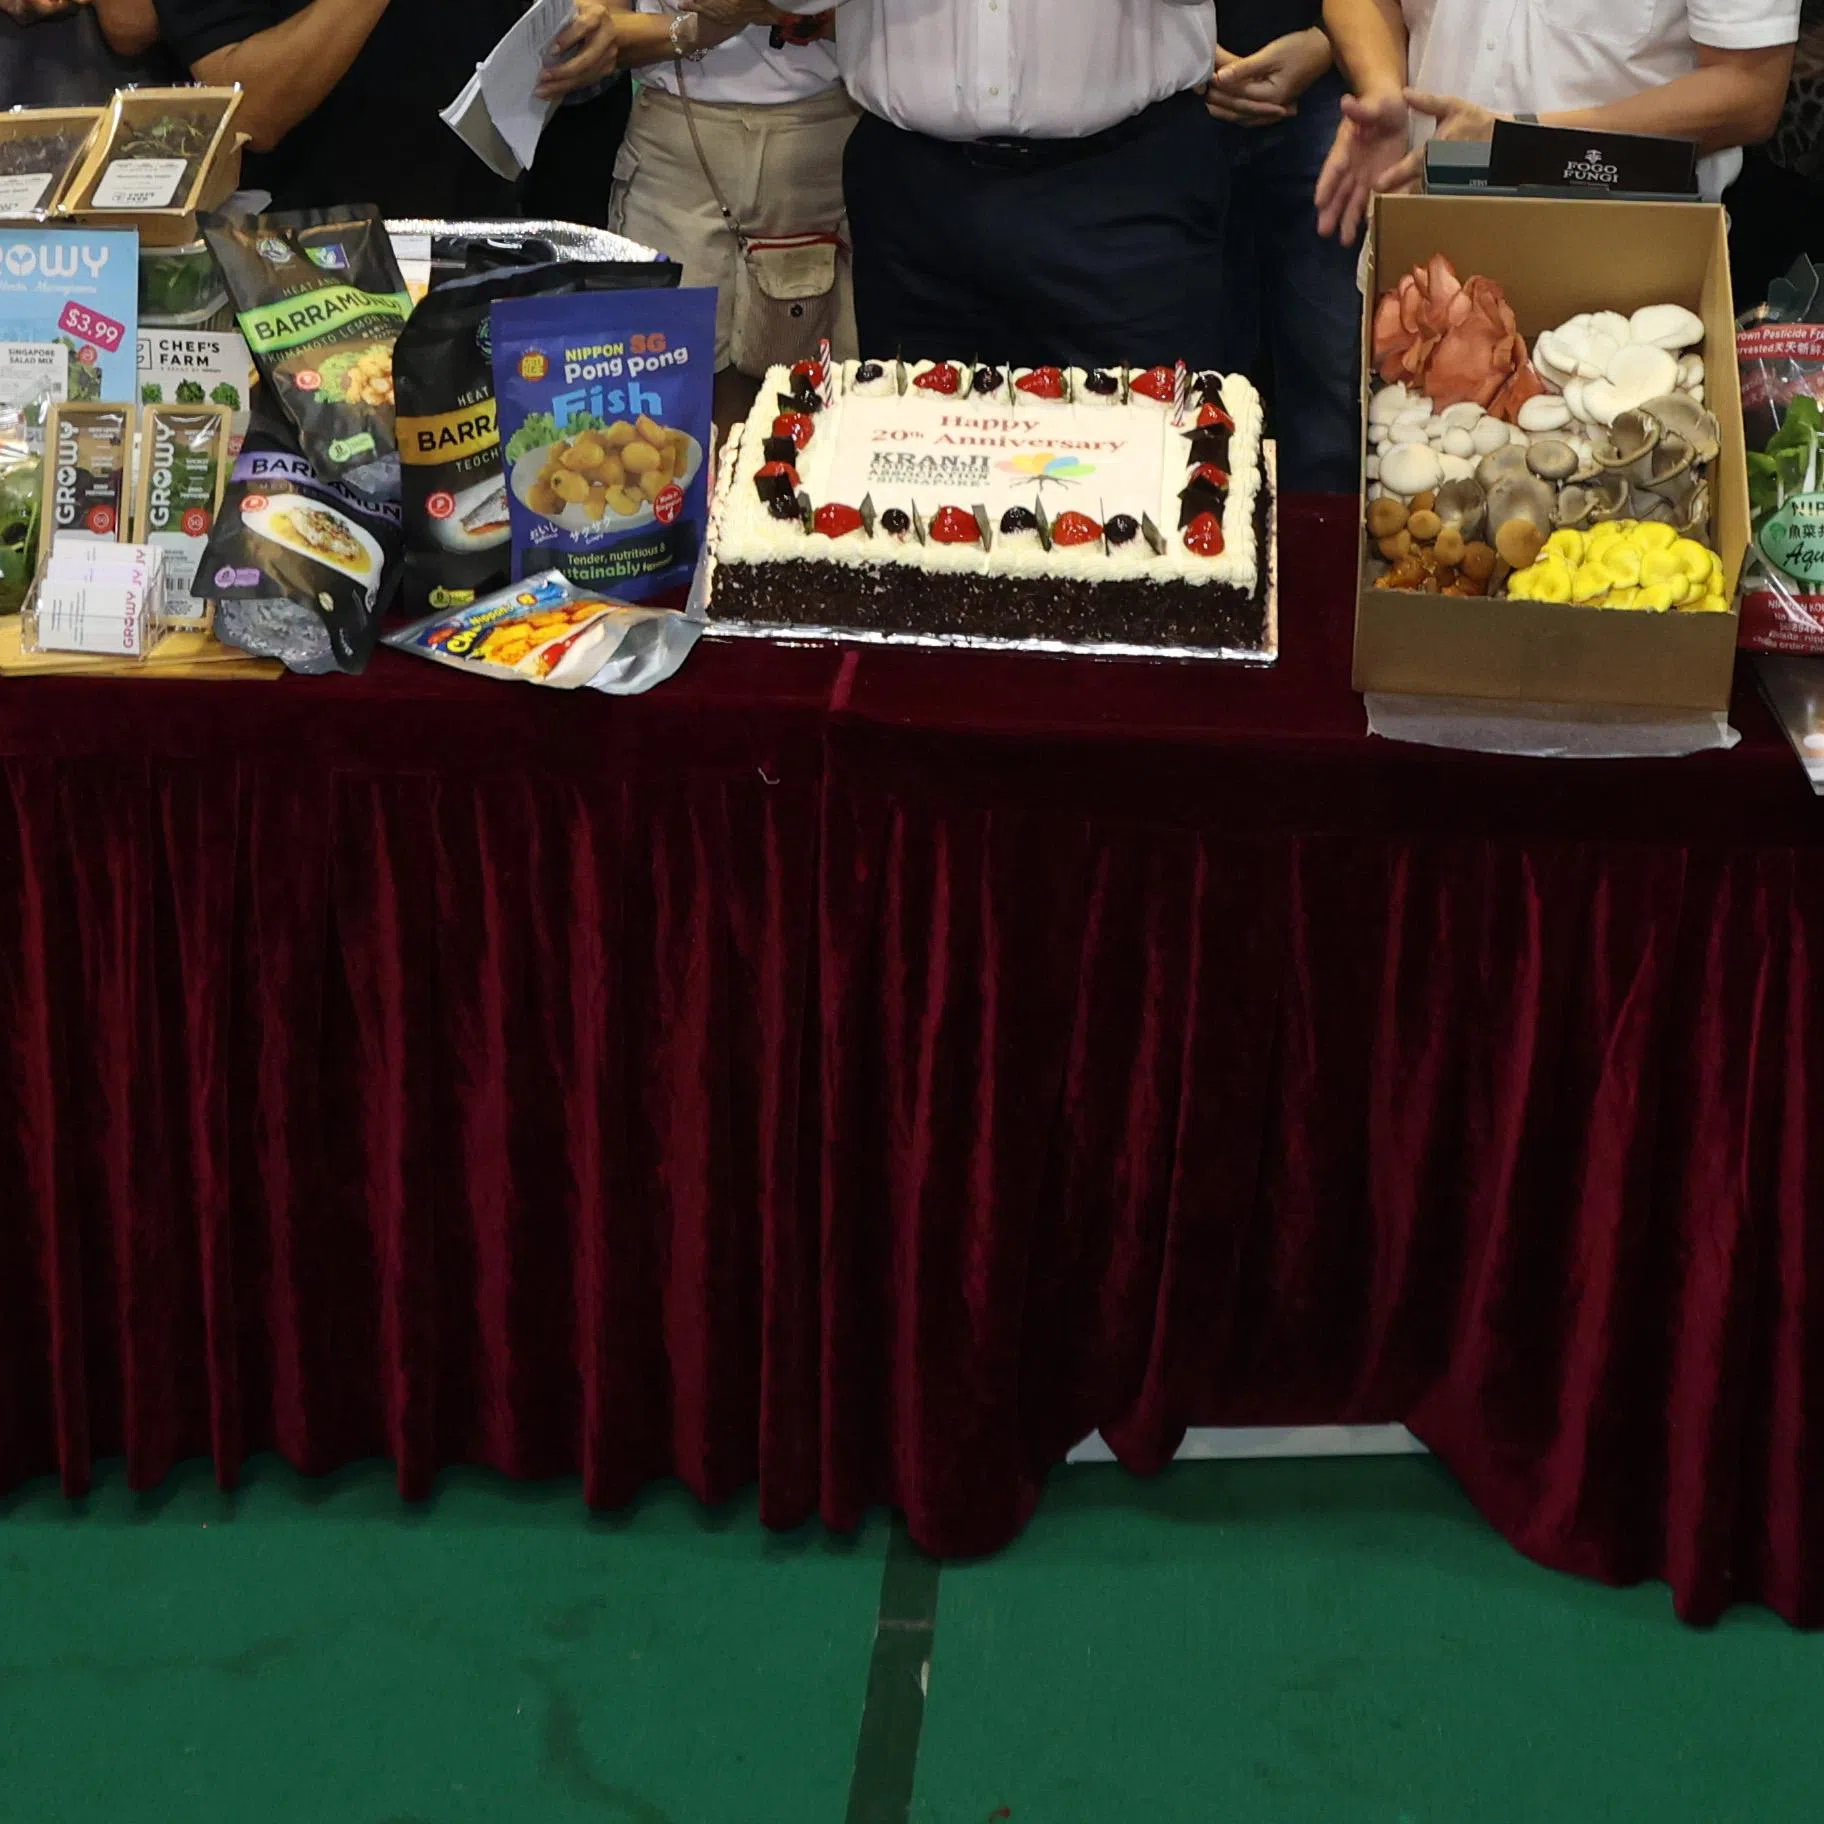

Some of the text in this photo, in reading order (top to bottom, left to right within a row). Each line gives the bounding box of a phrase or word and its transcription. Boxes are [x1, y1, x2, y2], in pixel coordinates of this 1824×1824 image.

[1563, 170, 1619, 183] FUNGI
[1567, 161, 1618, 174] FOGO
[282, 281, 313, 297] HEAT
[66, 307, 119, 344] $3.99
[1737, 331, 1760, 341] rown
[1763, 328, 1808, 340] Pesticide
[8, 348, 56, 358] SINGAPORE
[159, 339, 220, 354] CHEF'S
[564, 332, 667, 362] NIPPON SG
[9, 356, 54, 365] SALAD MIX
[160, 353, 210, 367] FARM
[458, 385, 491, 407] HEAT
[552, 381, 663, 428] Fish
[940, 415, 1040, 432] Happy
[871, 429, 1127, 453] 20th Anniversary
[456, 446, 502, 474] TEOCH
[871, 451, 991, 467] KRANJI
[55, 420, 79, 525] GROWY
[150, 422, 175, 527] GROWY
[567, 551, 608, 566] Tender,
[609, 546, 658, 562] nutritious
[122, 591, 137, 649] GROWY
